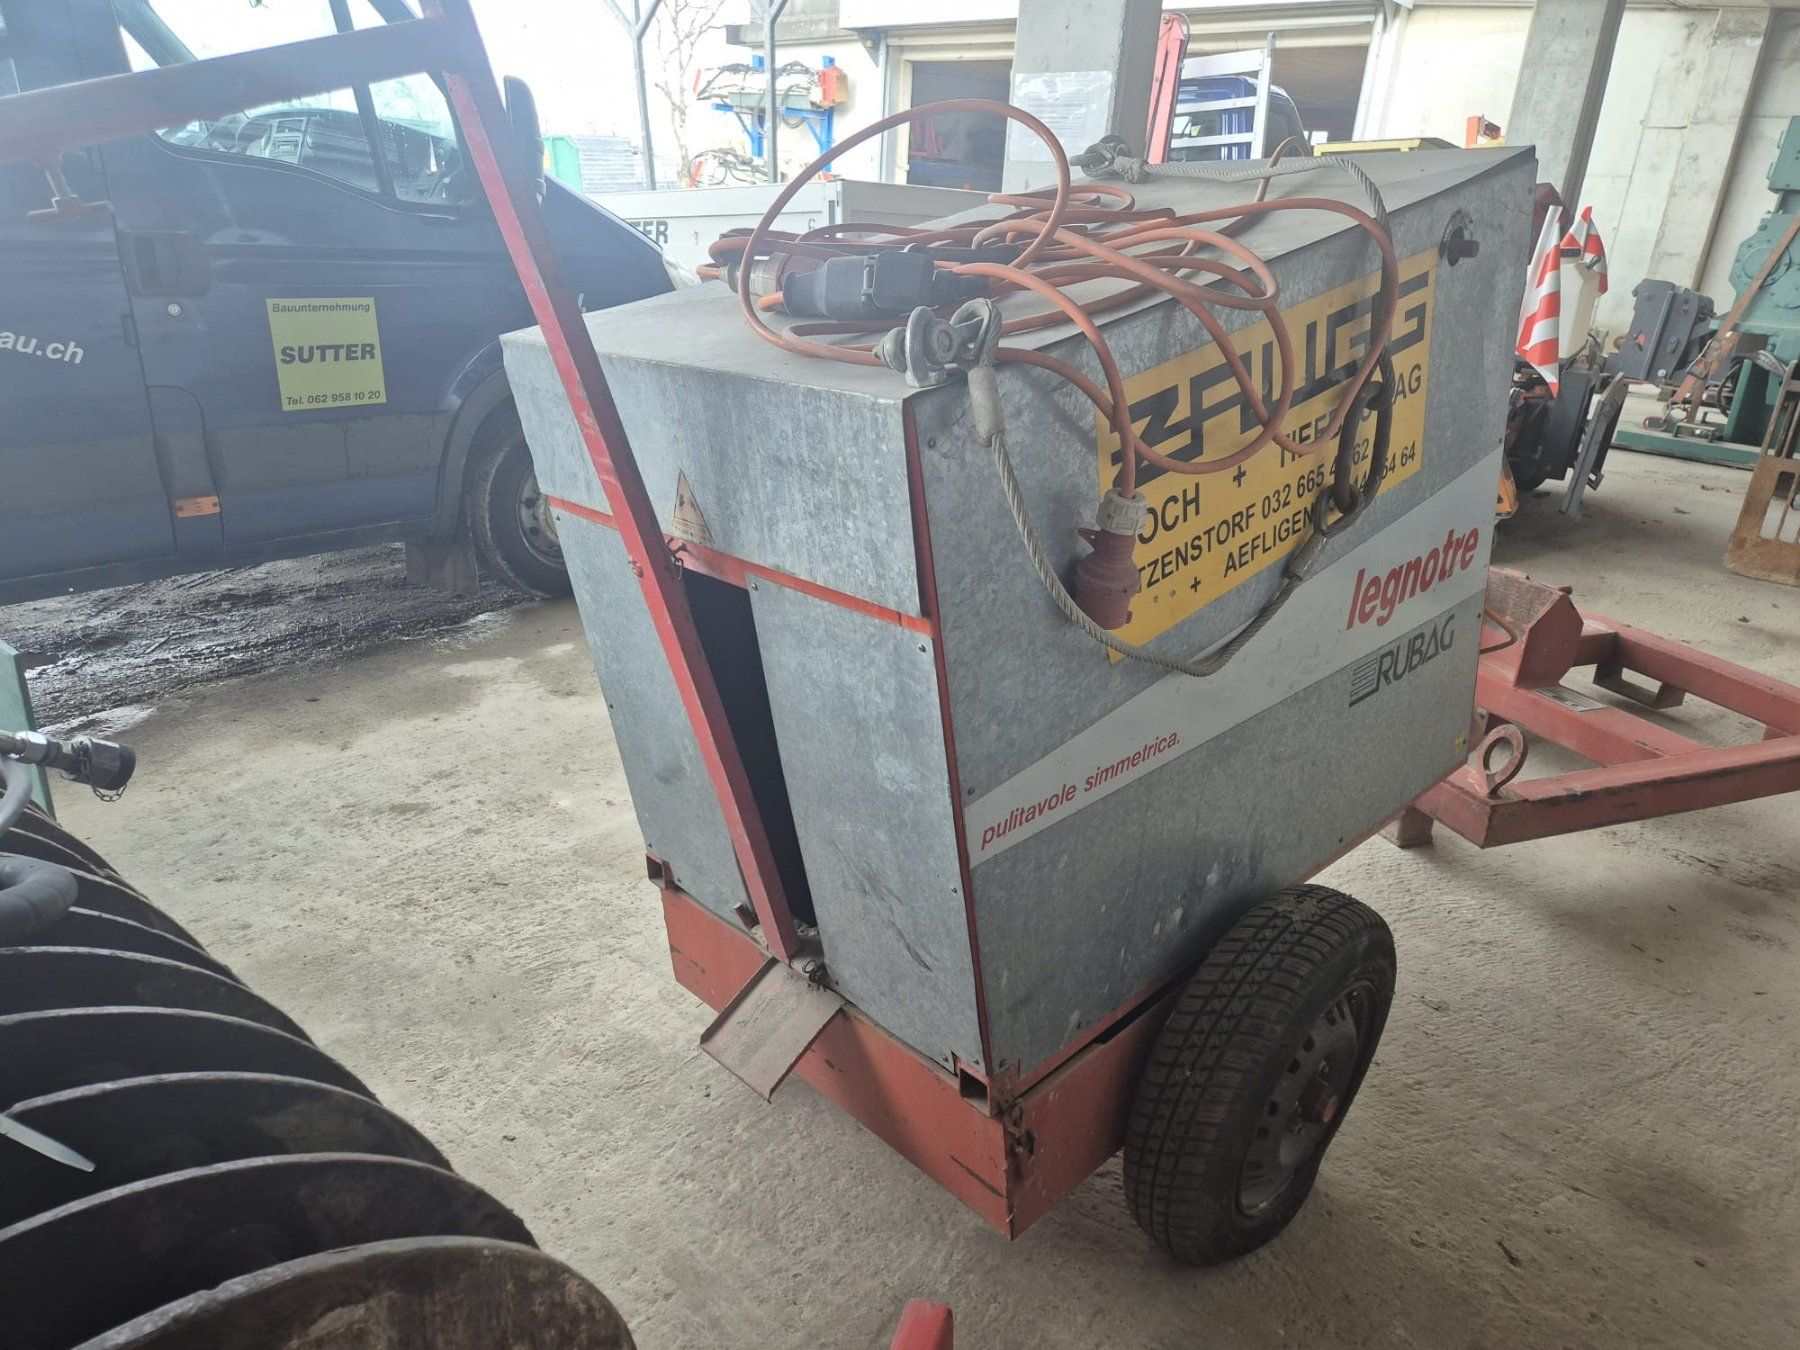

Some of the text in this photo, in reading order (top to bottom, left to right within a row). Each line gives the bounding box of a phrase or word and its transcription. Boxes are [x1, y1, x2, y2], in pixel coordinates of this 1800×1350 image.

[0, 331, 84, 364] au.ch
[272, 303, 371, 313] Bauunternehmung
[280, 343, 376, 365] SUTTER
[286, 390, 381, 406] Tel. 062 958 10 20
[1137, 483, 1200, 545] OCH
[1393, 363, 1422, 405] AG
[1137, 502, 1256, 593] TZENSTORF
[1262, 483, 1291, 520] 032
[1297, 463, 1325, 498] 665
[1353, 437, 1370, 466] 62
[1224, 502, 1315, 578] AEFLIGEN
[1401, 440, 1416, 468] 64
[1346, 527, 1479, 631] legnotre
[1360, 613, 1455, 699] RUBAG
[981, 732, 1181, 851] pulitavole simmetrica.
